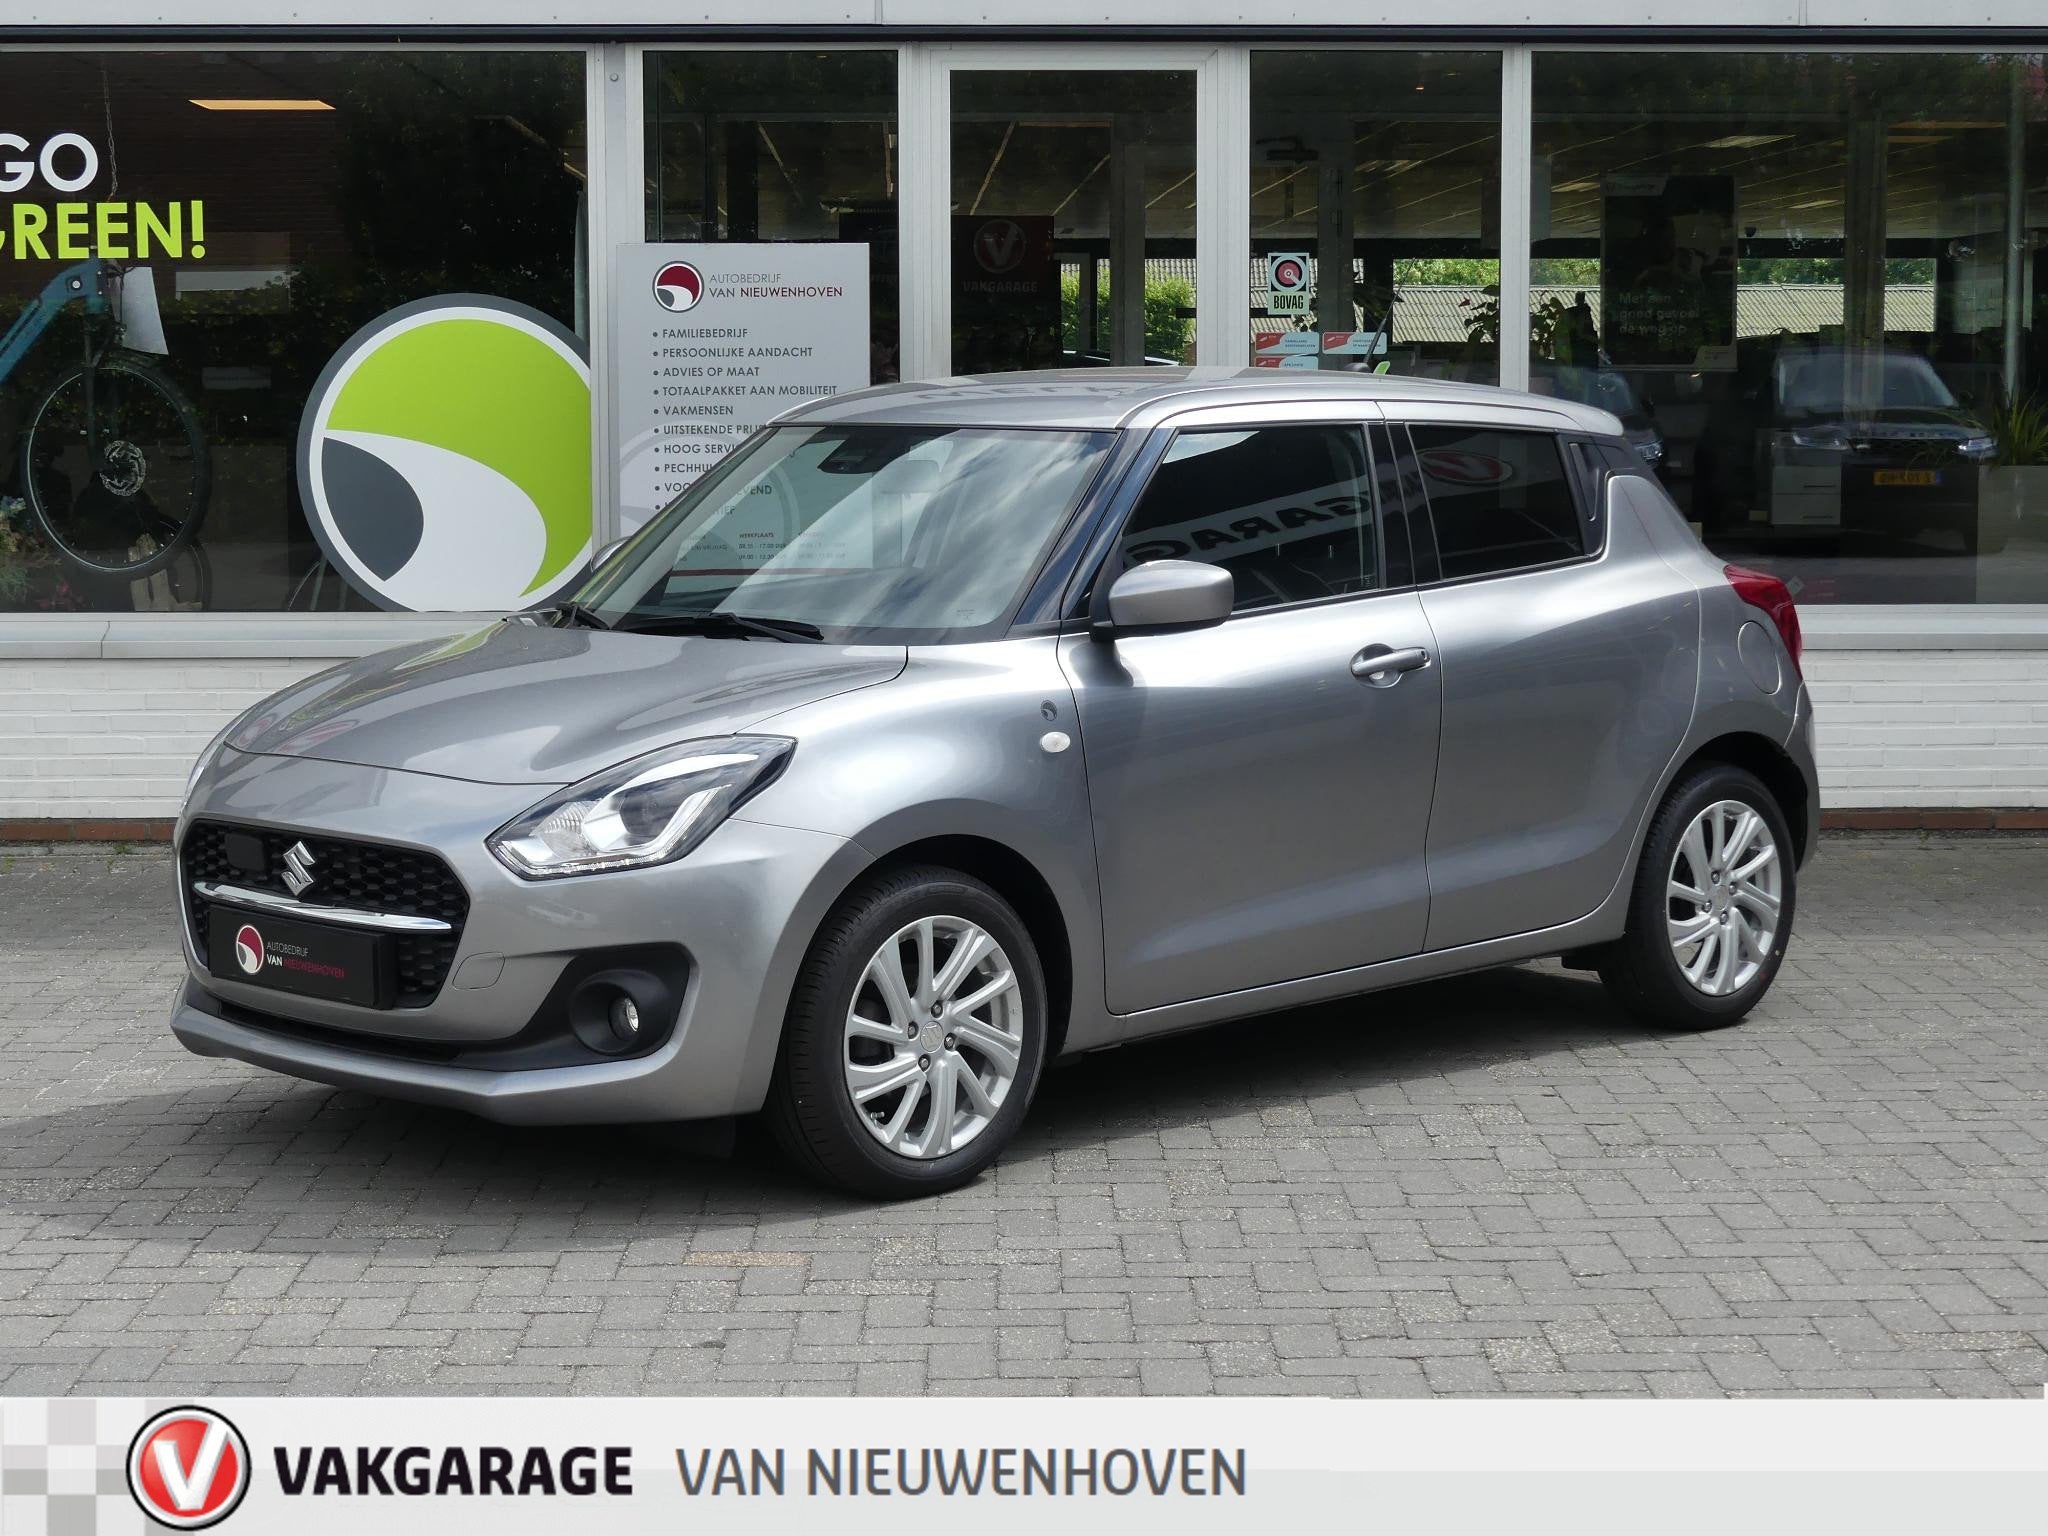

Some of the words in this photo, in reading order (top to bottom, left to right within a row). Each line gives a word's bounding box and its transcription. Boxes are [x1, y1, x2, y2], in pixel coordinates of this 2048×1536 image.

[0, 132, 99, 193] GO
[0, 200, 206, 260] REEN!
[709, 273, 782, 285] AUTOBEDRIJF
[709, 287, 735, 298] VAN
[740, 286, 843, 298] NIEUWENHOVEN
[1273, 294, 1304, 310] BOVAG
[662, 328, 748, 339] FAMILIEBEDRIJF
[662, 347, 745, 358] PERSOONLIJKE
[747, 347, 813, 357] AANDACHT
[662, 367, 704, 377] ADVIES
[707, 367, 723, 377] OP
[726, 366, 760, 377] MAAT
[662, 385, 747, 397] TOTAALPAKKET
[749, 385, 776, 396] AAN
[778, 385, 837, 396] MOBILITEIT
[663, 405, 734, 416] VAKMENSEN
[663, 424, 733, 435] UITSTEKENDE
[664, 443, 701, 454] HOOG
[266, 953, 283, 967] VAN
